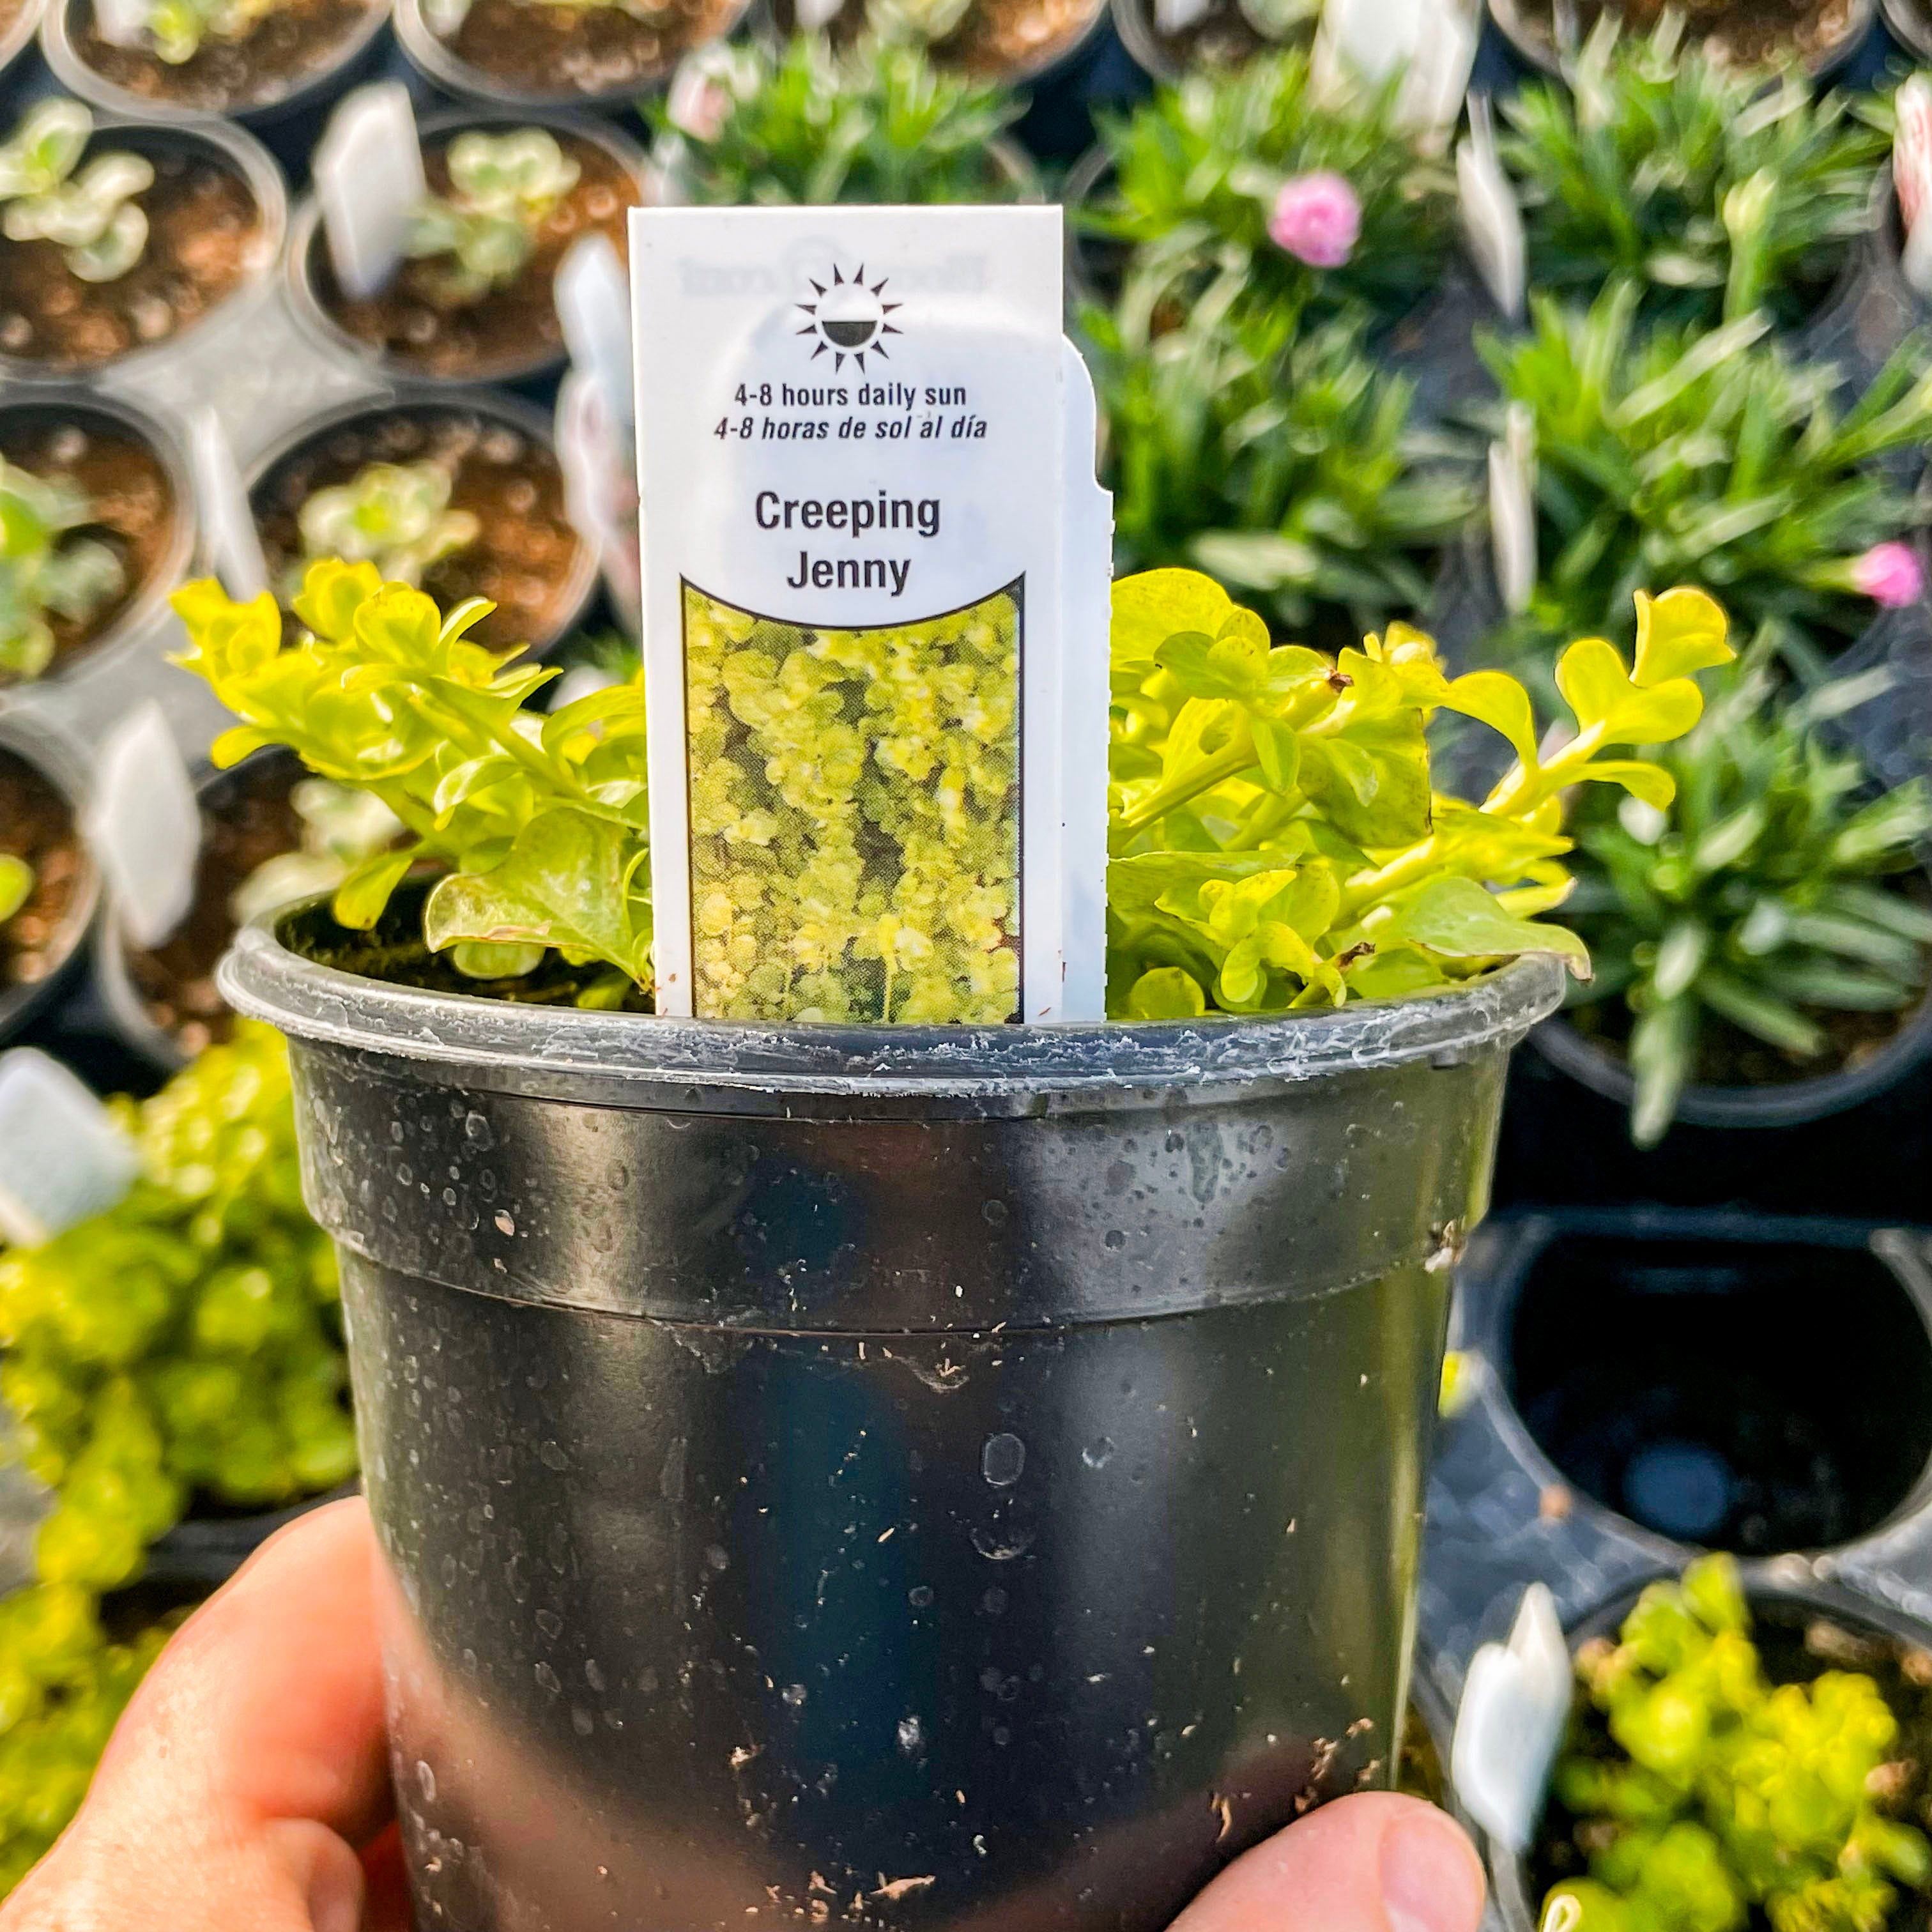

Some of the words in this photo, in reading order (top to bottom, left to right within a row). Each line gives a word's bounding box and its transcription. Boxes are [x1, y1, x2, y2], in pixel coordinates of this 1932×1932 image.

[735, 383, 772, 406] 4-8
[782, 383, 848, 406] hours
[858, 383, 916, 411] daily
[925, 388, 966, 406] sun
[714, 417, 753, 440] 4-8
[762, 417, 829, 440] horas
[838, 416, 866, 439] de
[875, 415, 912, 439] sol
[919, 415, 943, 439] al
[951, 415, 987, 439] día
[756, 489, 940, 538] Creeping
[786, 551, 911, 597] Jenny
